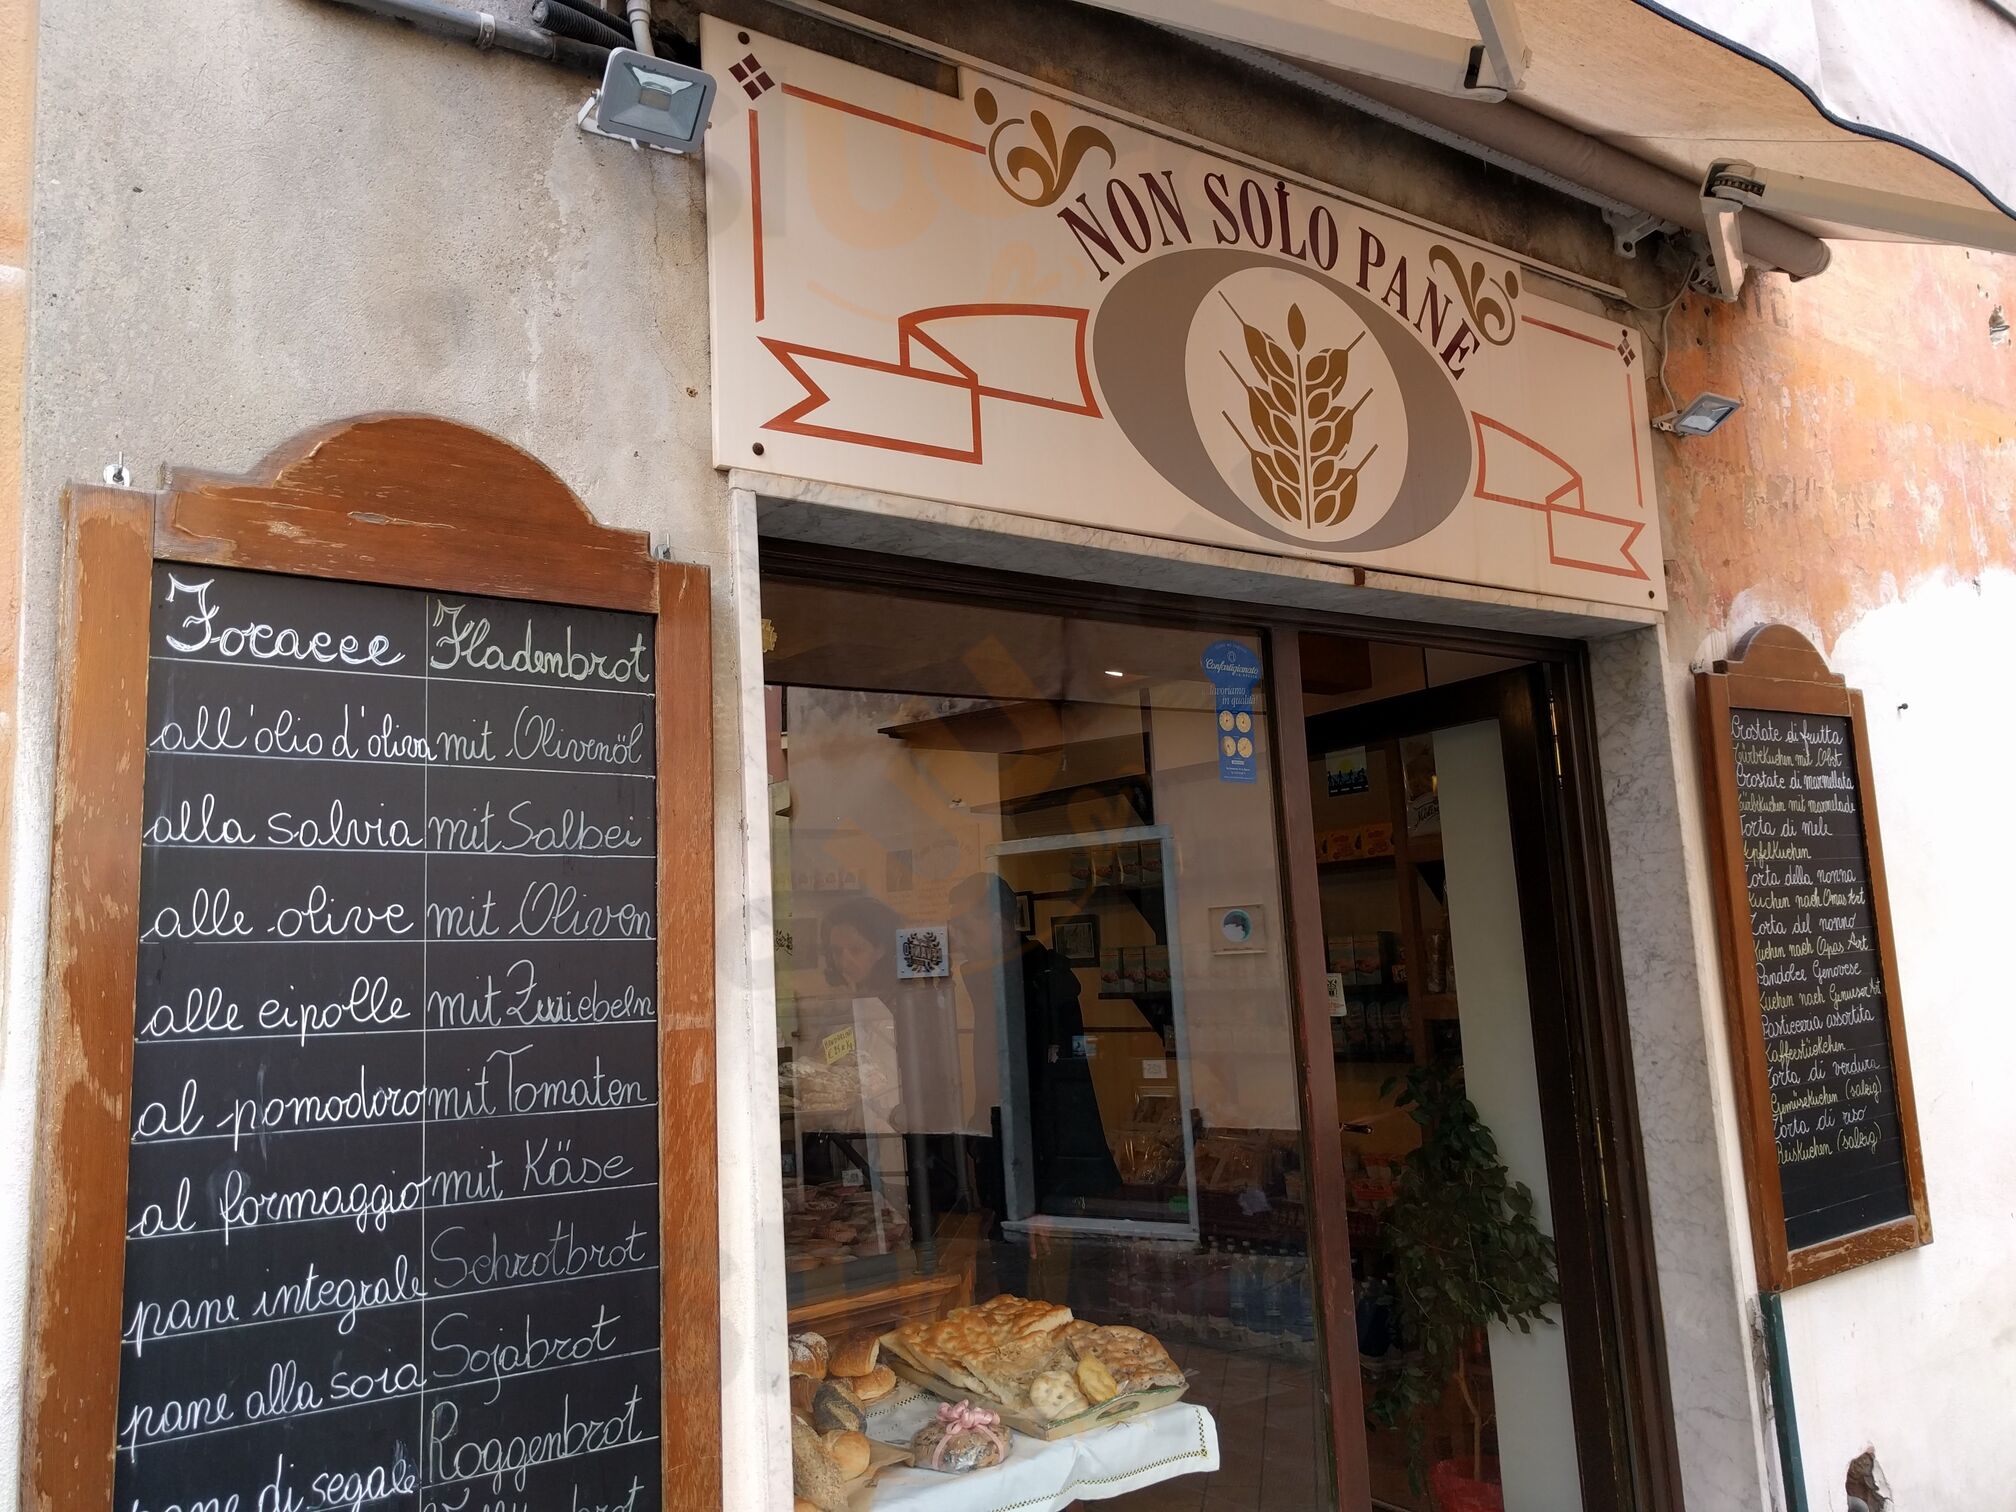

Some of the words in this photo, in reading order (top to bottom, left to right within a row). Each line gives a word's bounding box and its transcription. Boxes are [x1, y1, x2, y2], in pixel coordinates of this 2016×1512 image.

[1057, 169, 1192, 282] NON
[1203, 172, 1340, 271] SOLO
[1355, 226, 1481, 381] PANE
[430, 599, 650, 683] Fladenbrot
[437, 720, 496, 762] mit
[144, 793, 256, 843] alla
[267, 799, 423, 848] salvia
[428, 801, 503, 853] mit
[502, 801, 642, 851] Salbei
[1780, 817, 1797, 837] di
[143, 887, 254, 938] alle
[267, 885, 414, 938] olive
[427, 890, 501, 939] mit
[509, 881, 652, 940] Oliven
[1791, 912, 1812, 935] del
[140, 987, 243, 1038] alle
[427, 975, 502, 1028] mit
[426, 1066, 497, 1121] mit
[486, 1044, 648, 1113] Tomaten
[1807, 1059, 1827, 1081] di
[132, 1078, 204, 1141] al
[217, 1065, 428, 1152] pomodoro
[1815, 1107, 1836, 1131] di
[430, 1144, 504, 1201] mit
[522, 1138, 636, 1192] Käse
[126, 1177, 197, 1237] al
[219, 1170, 431, 1246] formaggio
[122, 1287, 240, 1358] pane
[252, 1254, 428, 1335] integrale
[431, 1304, 621, 1406] Sojabrot
[120, 1395, 240, 1464] pane
[246, 1360, 325, 1414] alla
[428, 1384, 644, 1488] Roggenbrot
